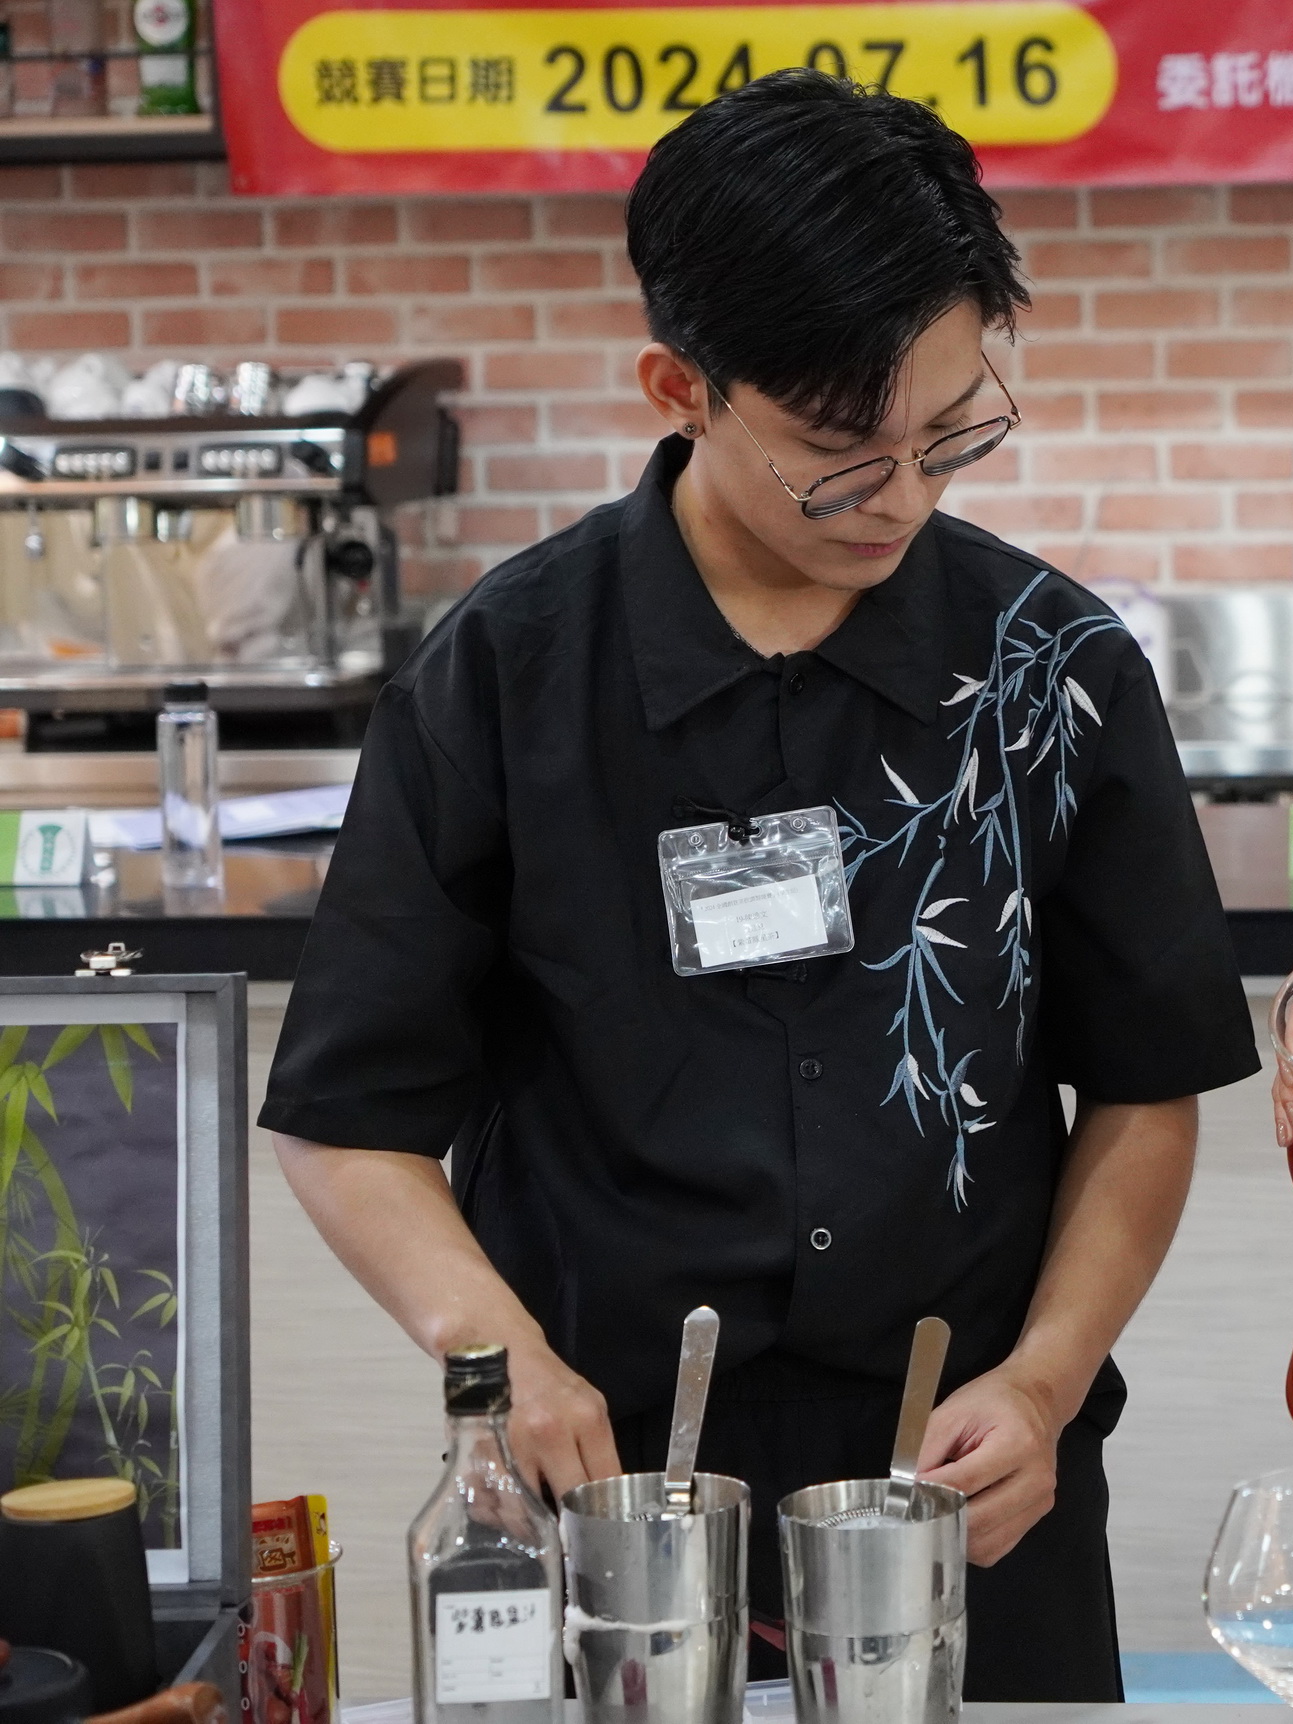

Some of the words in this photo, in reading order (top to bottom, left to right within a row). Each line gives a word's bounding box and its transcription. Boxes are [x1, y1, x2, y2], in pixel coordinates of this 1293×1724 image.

[316, 57, 515, 105] 競賽日期
[544, 37, 1059, 113] 20247.16
